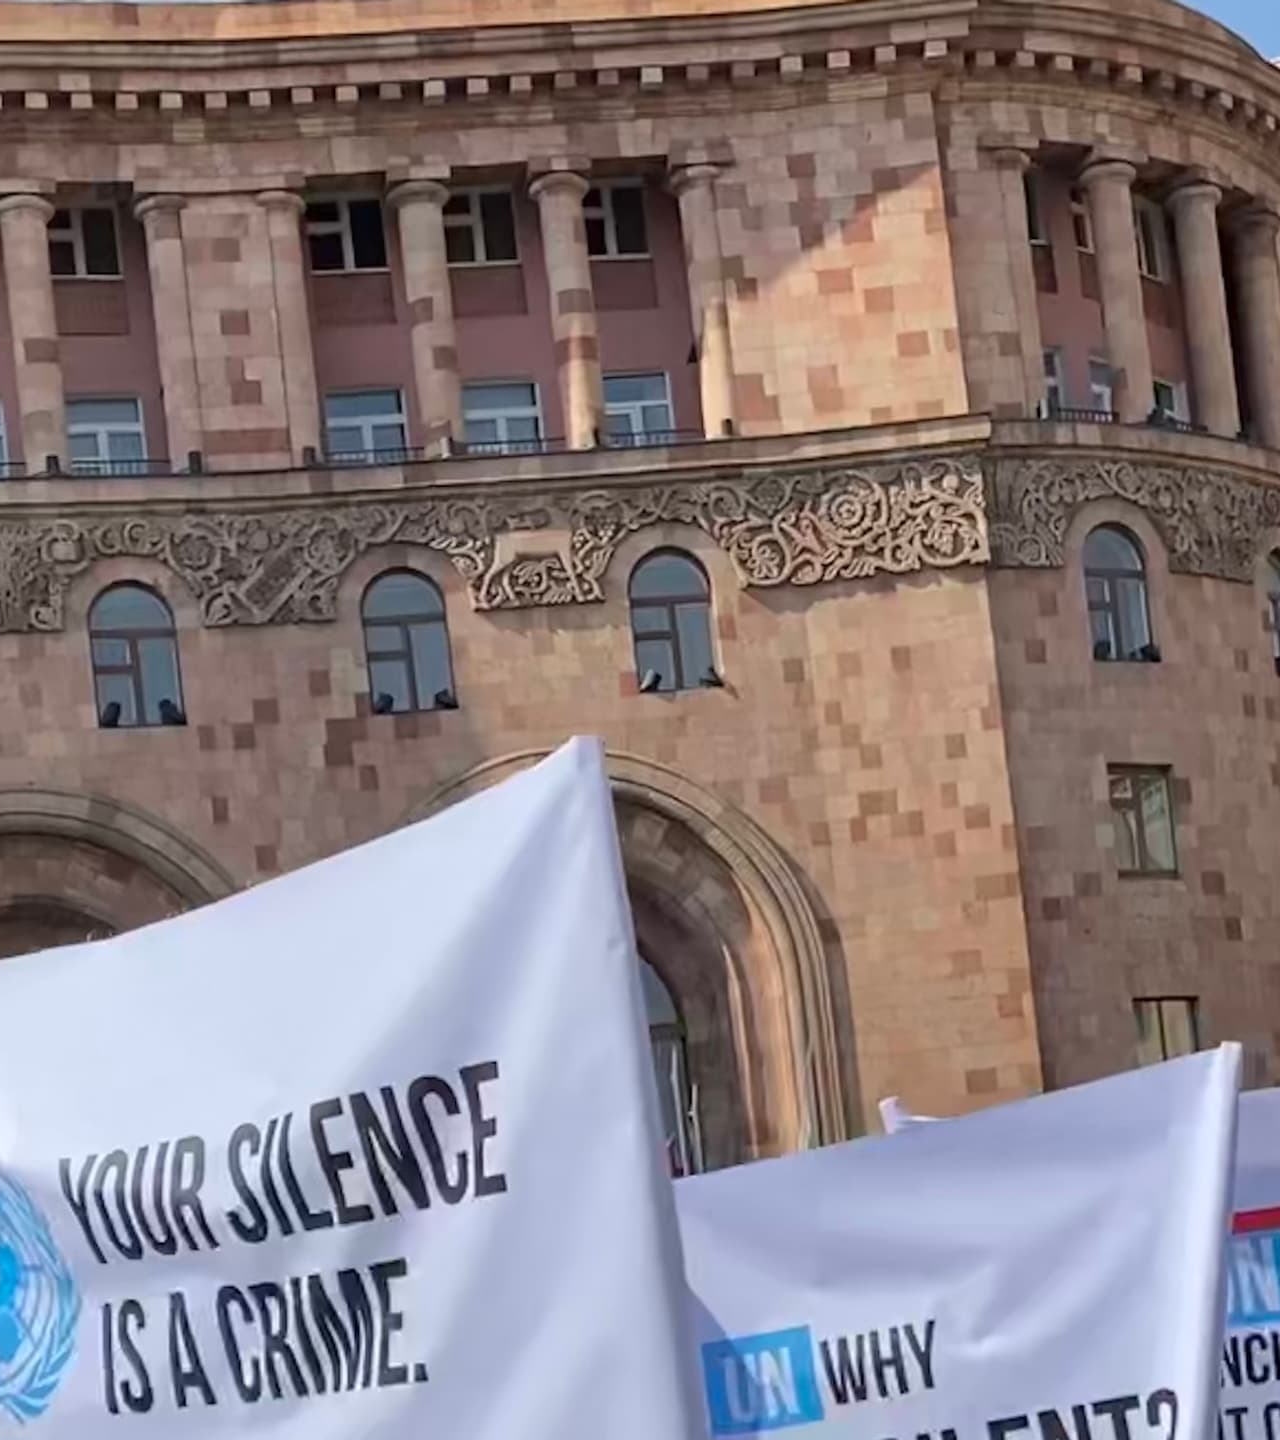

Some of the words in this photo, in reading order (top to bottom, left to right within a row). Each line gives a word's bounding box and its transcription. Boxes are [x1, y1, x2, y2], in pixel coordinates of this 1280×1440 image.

[58, 1135, 220, 1265] YOUR
[227, 1061, 507, 1245] SILENCE
[102, 1298, 154, 1414] IS
[169, 1292, 218, 1408] A
[216, 1258, 429, 1405] CRIME.
[720, 1346, 800, 1425] UN
[819, 1319, 938, 1406] WHY
